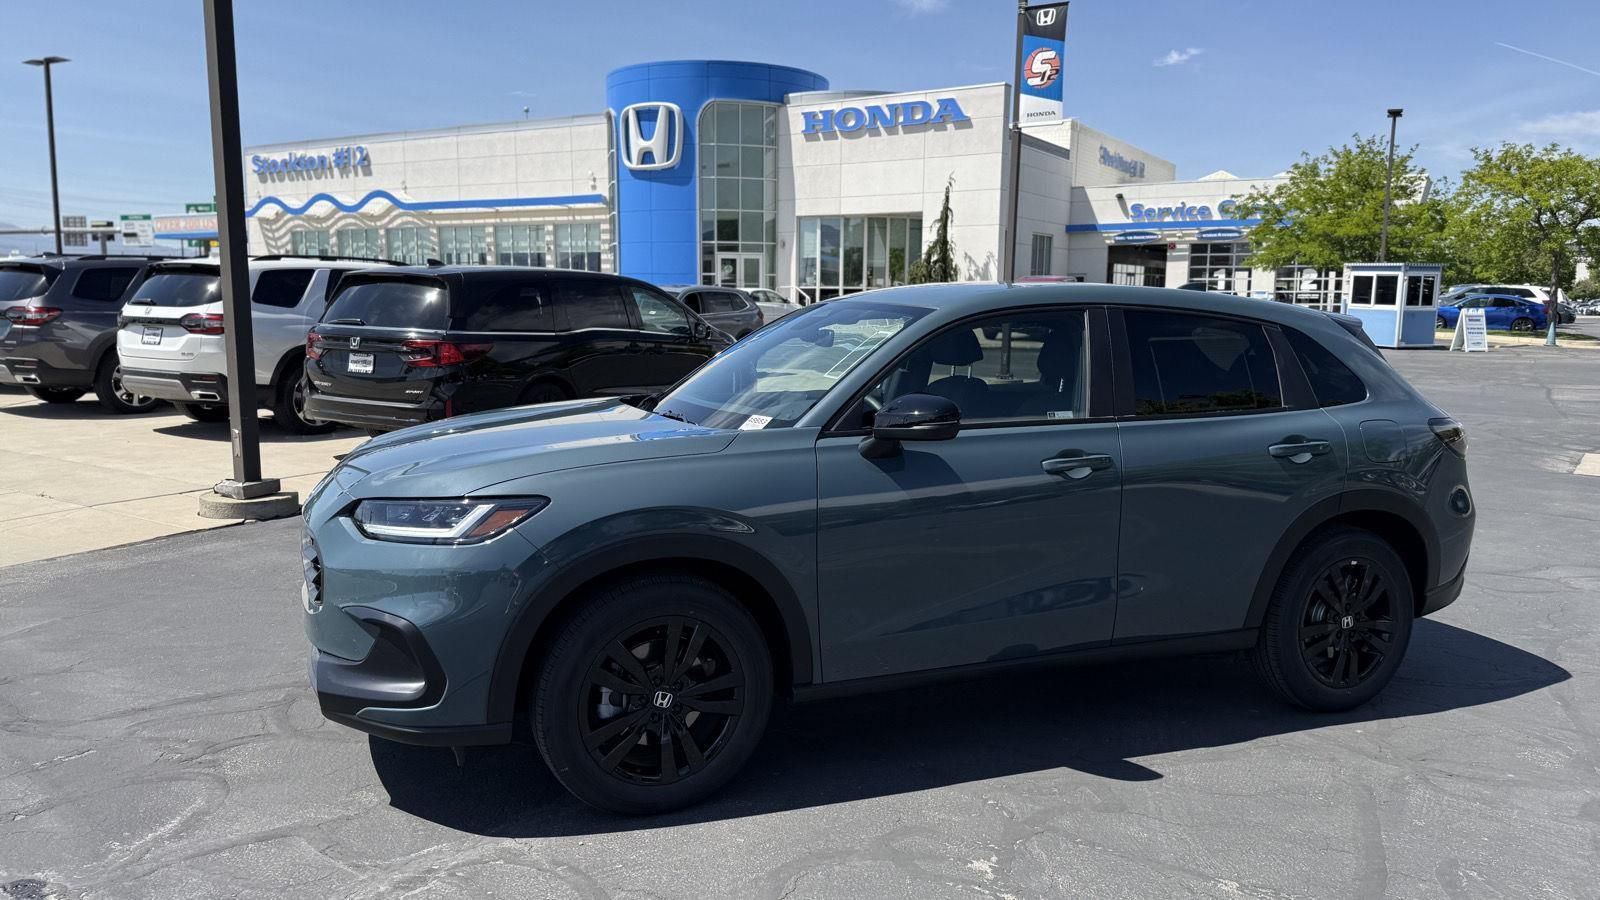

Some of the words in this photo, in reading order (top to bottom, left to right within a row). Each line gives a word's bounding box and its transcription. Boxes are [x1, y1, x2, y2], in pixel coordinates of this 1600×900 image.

[801, 97, 971, 134] HONDA
[1026, 110, 1057, 118] HONDA
[252, 151, 328, 175] Stockton
[333, 145, 367, 169] #12
[1129, 201, 1212, 222] Service
[1213, 268, 1226, 290] 1
[1300, 268, 1319, 290] 2
